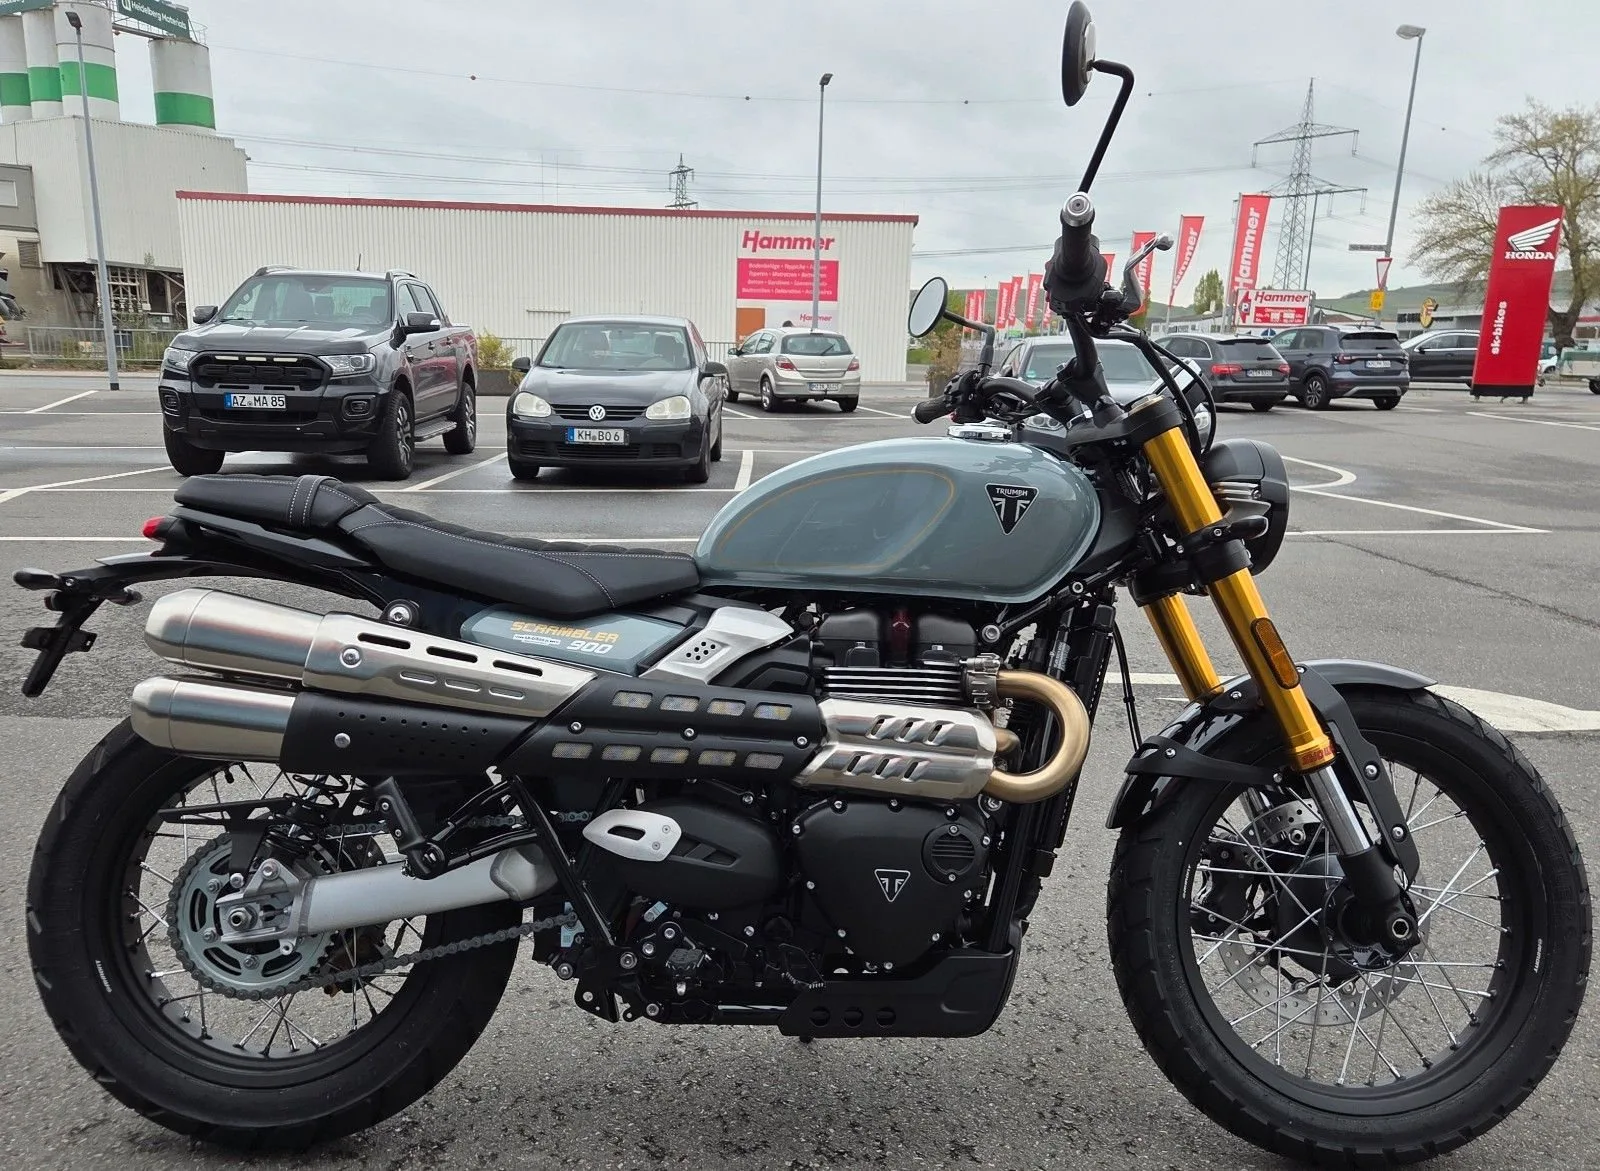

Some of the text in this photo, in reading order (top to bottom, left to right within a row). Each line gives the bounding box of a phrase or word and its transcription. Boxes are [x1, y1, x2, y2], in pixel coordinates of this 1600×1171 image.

[132, 1, 187, 30] Heidelberg Materials
[1504, 251, 1555, 260] HONDA
[1255, 291, 1309, 303] Hammer
[233, 396, 285, 407] AZ MA 85
[578, 430, 591, 440] KH
[614, 432, 620, 441] 6
[996, 488, 1028, 497] TRIUMPH
[510, 621, 620, 643] SCRAMBLER
[566, 640, 614, 654] 900
